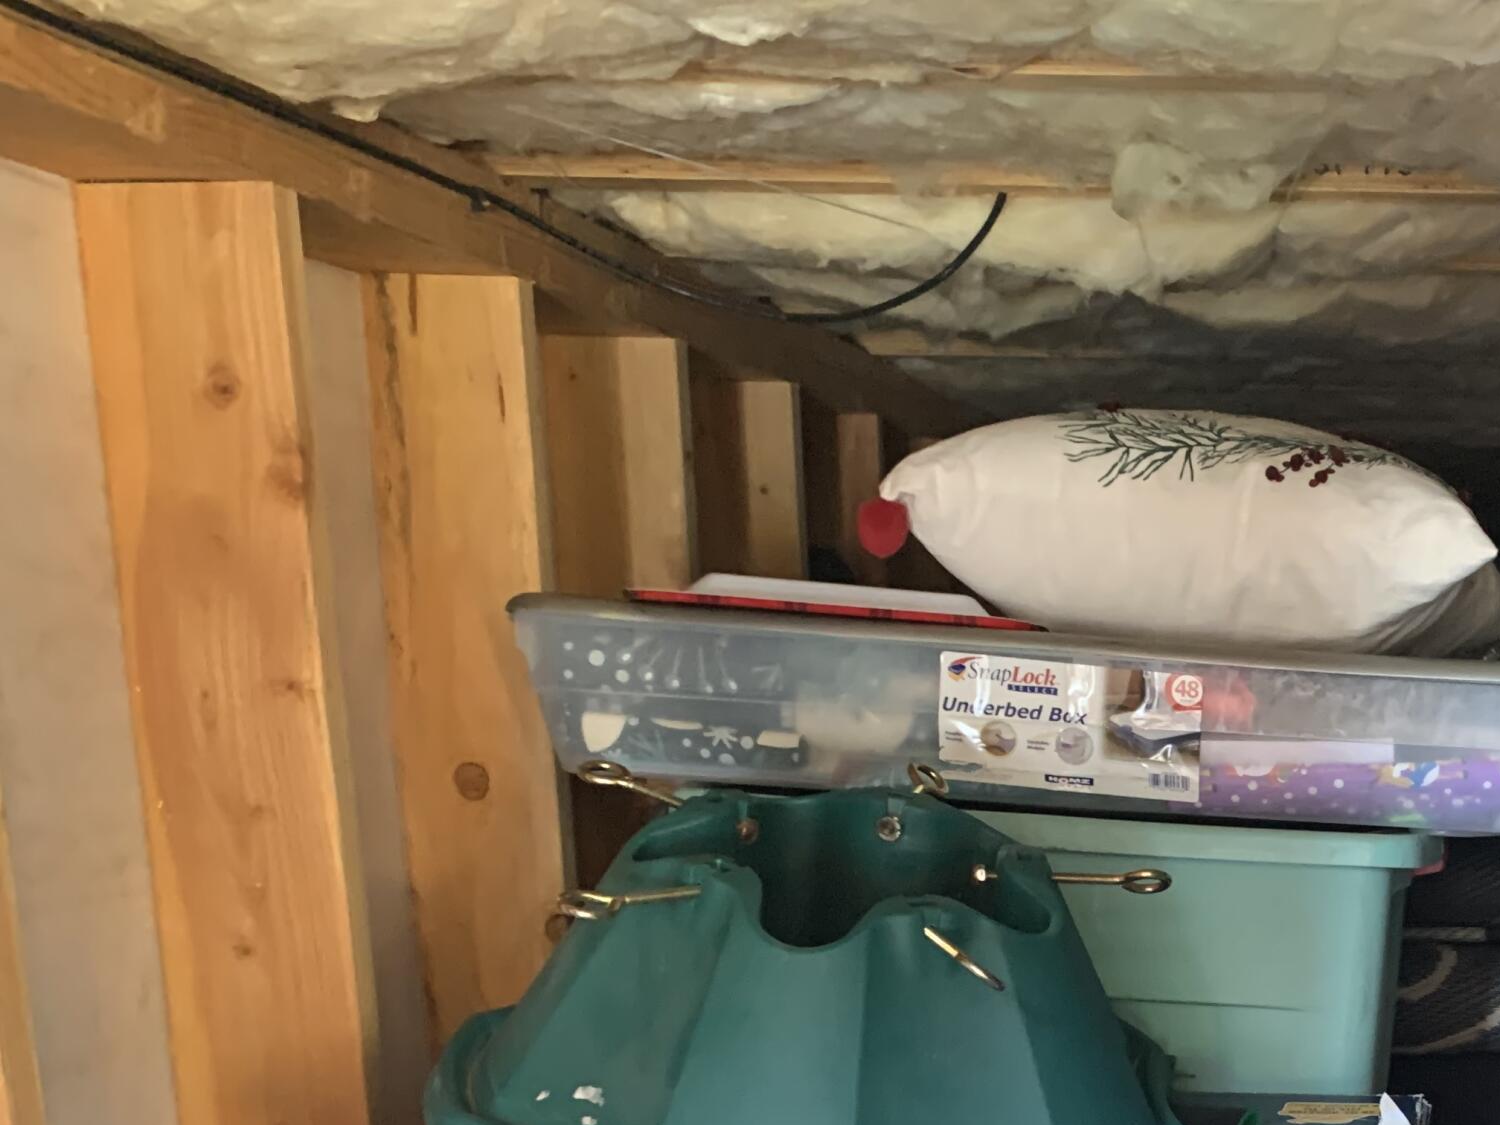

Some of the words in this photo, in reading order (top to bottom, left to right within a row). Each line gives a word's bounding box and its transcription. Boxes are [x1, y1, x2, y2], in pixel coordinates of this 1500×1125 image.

[1011, 684, 1057, 696] SELECT
[1175, 680, 1200, 698] 48
[1049, 708, 1087, 725] Box
